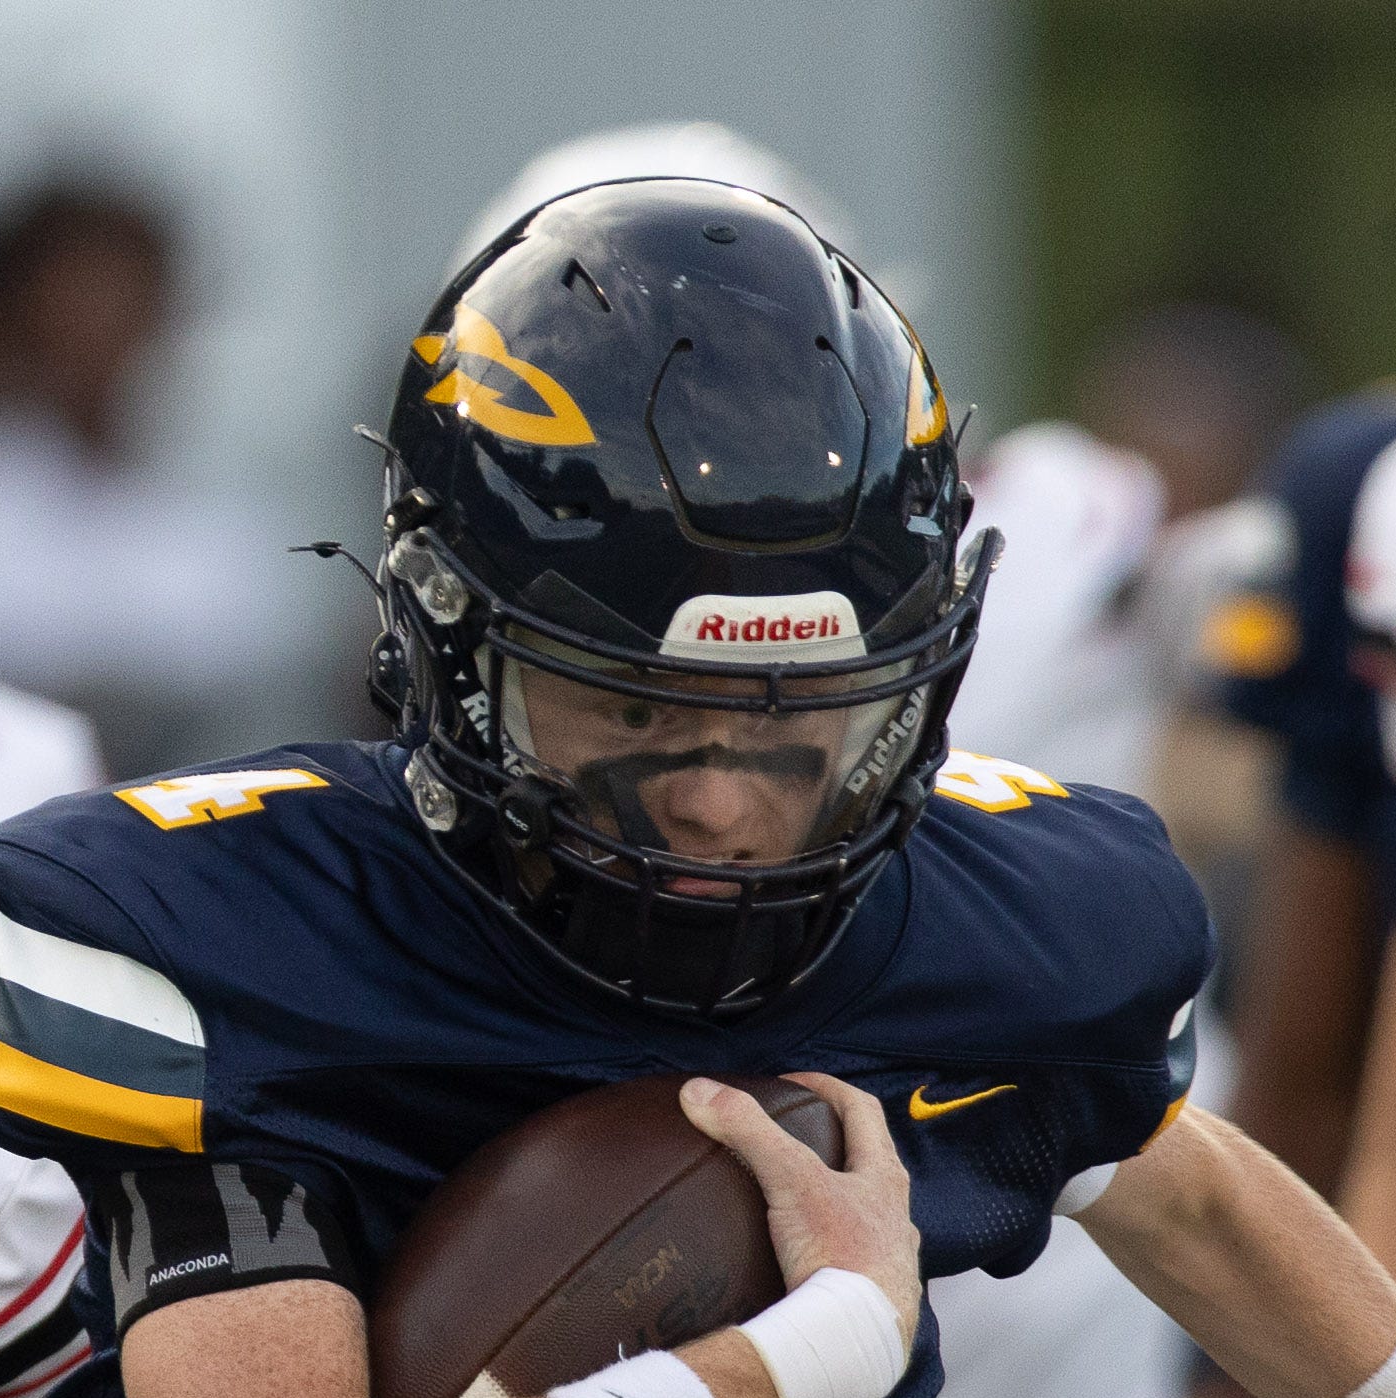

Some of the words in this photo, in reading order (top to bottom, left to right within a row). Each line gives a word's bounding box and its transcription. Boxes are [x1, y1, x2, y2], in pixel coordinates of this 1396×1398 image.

[697, 613, 841, 642] Riddell
[113, 767, 332, 831] 4
[149, 1252, 229, 1286] ANACONDA
